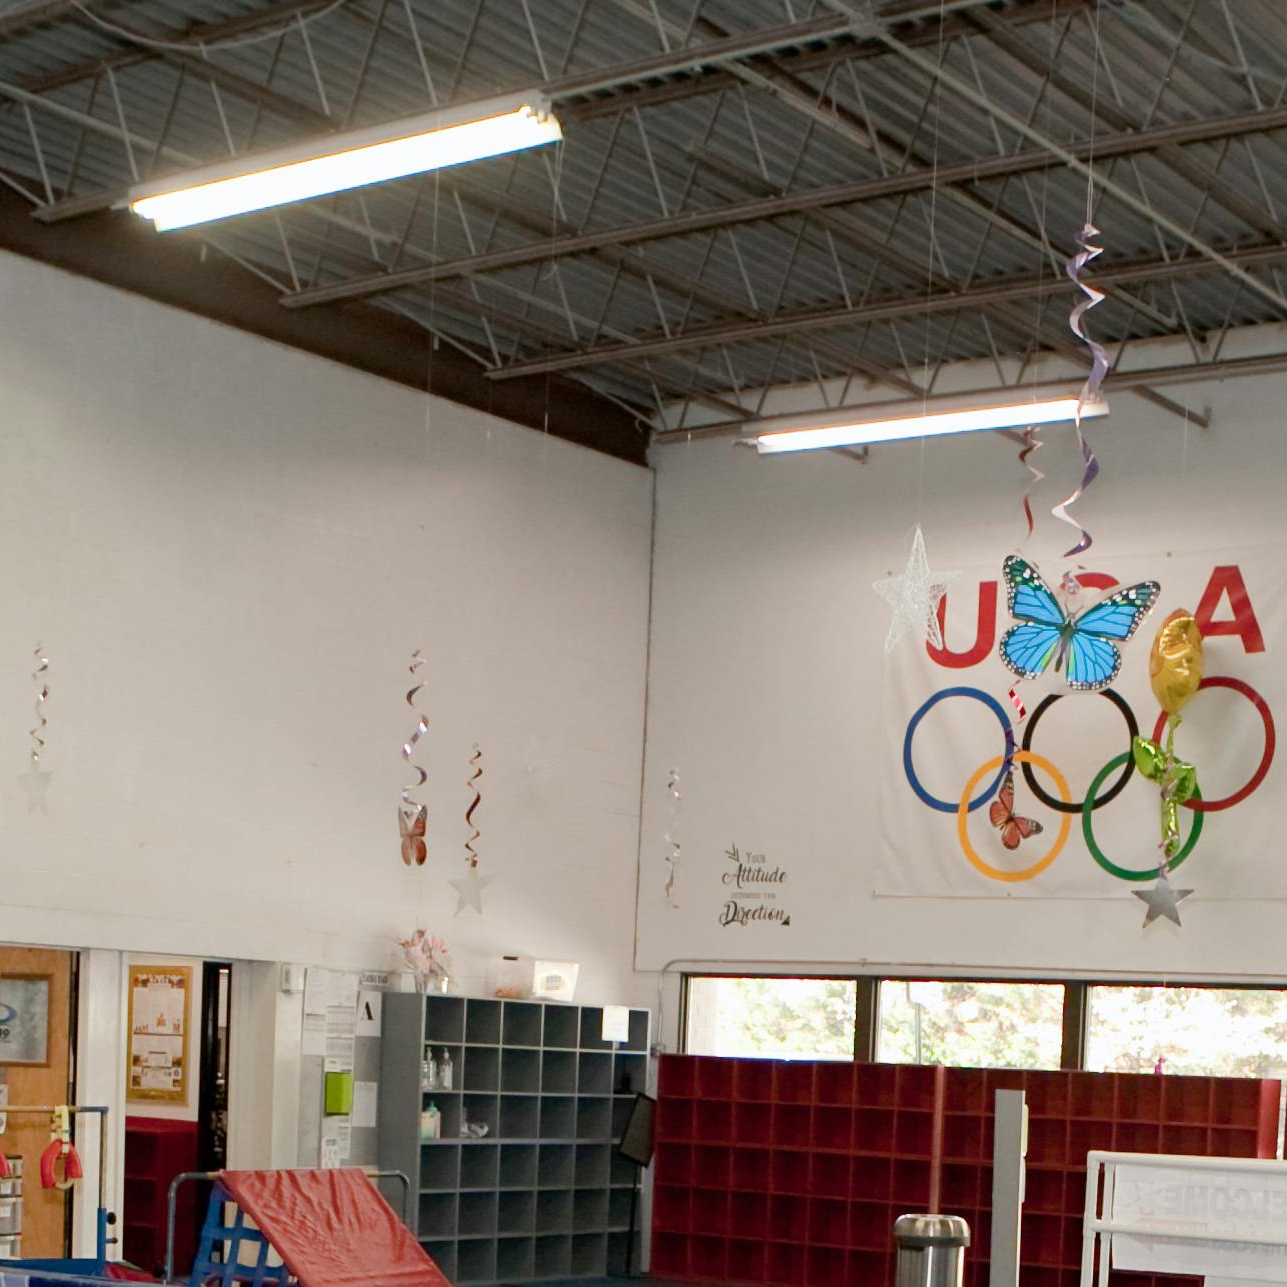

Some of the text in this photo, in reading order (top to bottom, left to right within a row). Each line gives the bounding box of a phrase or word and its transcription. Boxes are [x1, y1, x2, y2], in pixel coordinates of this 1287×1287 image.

[925, 564, 1266, 669] UA
[721, 863, 787, 889] Attitude
[719, 900, 786, 927] Direction
